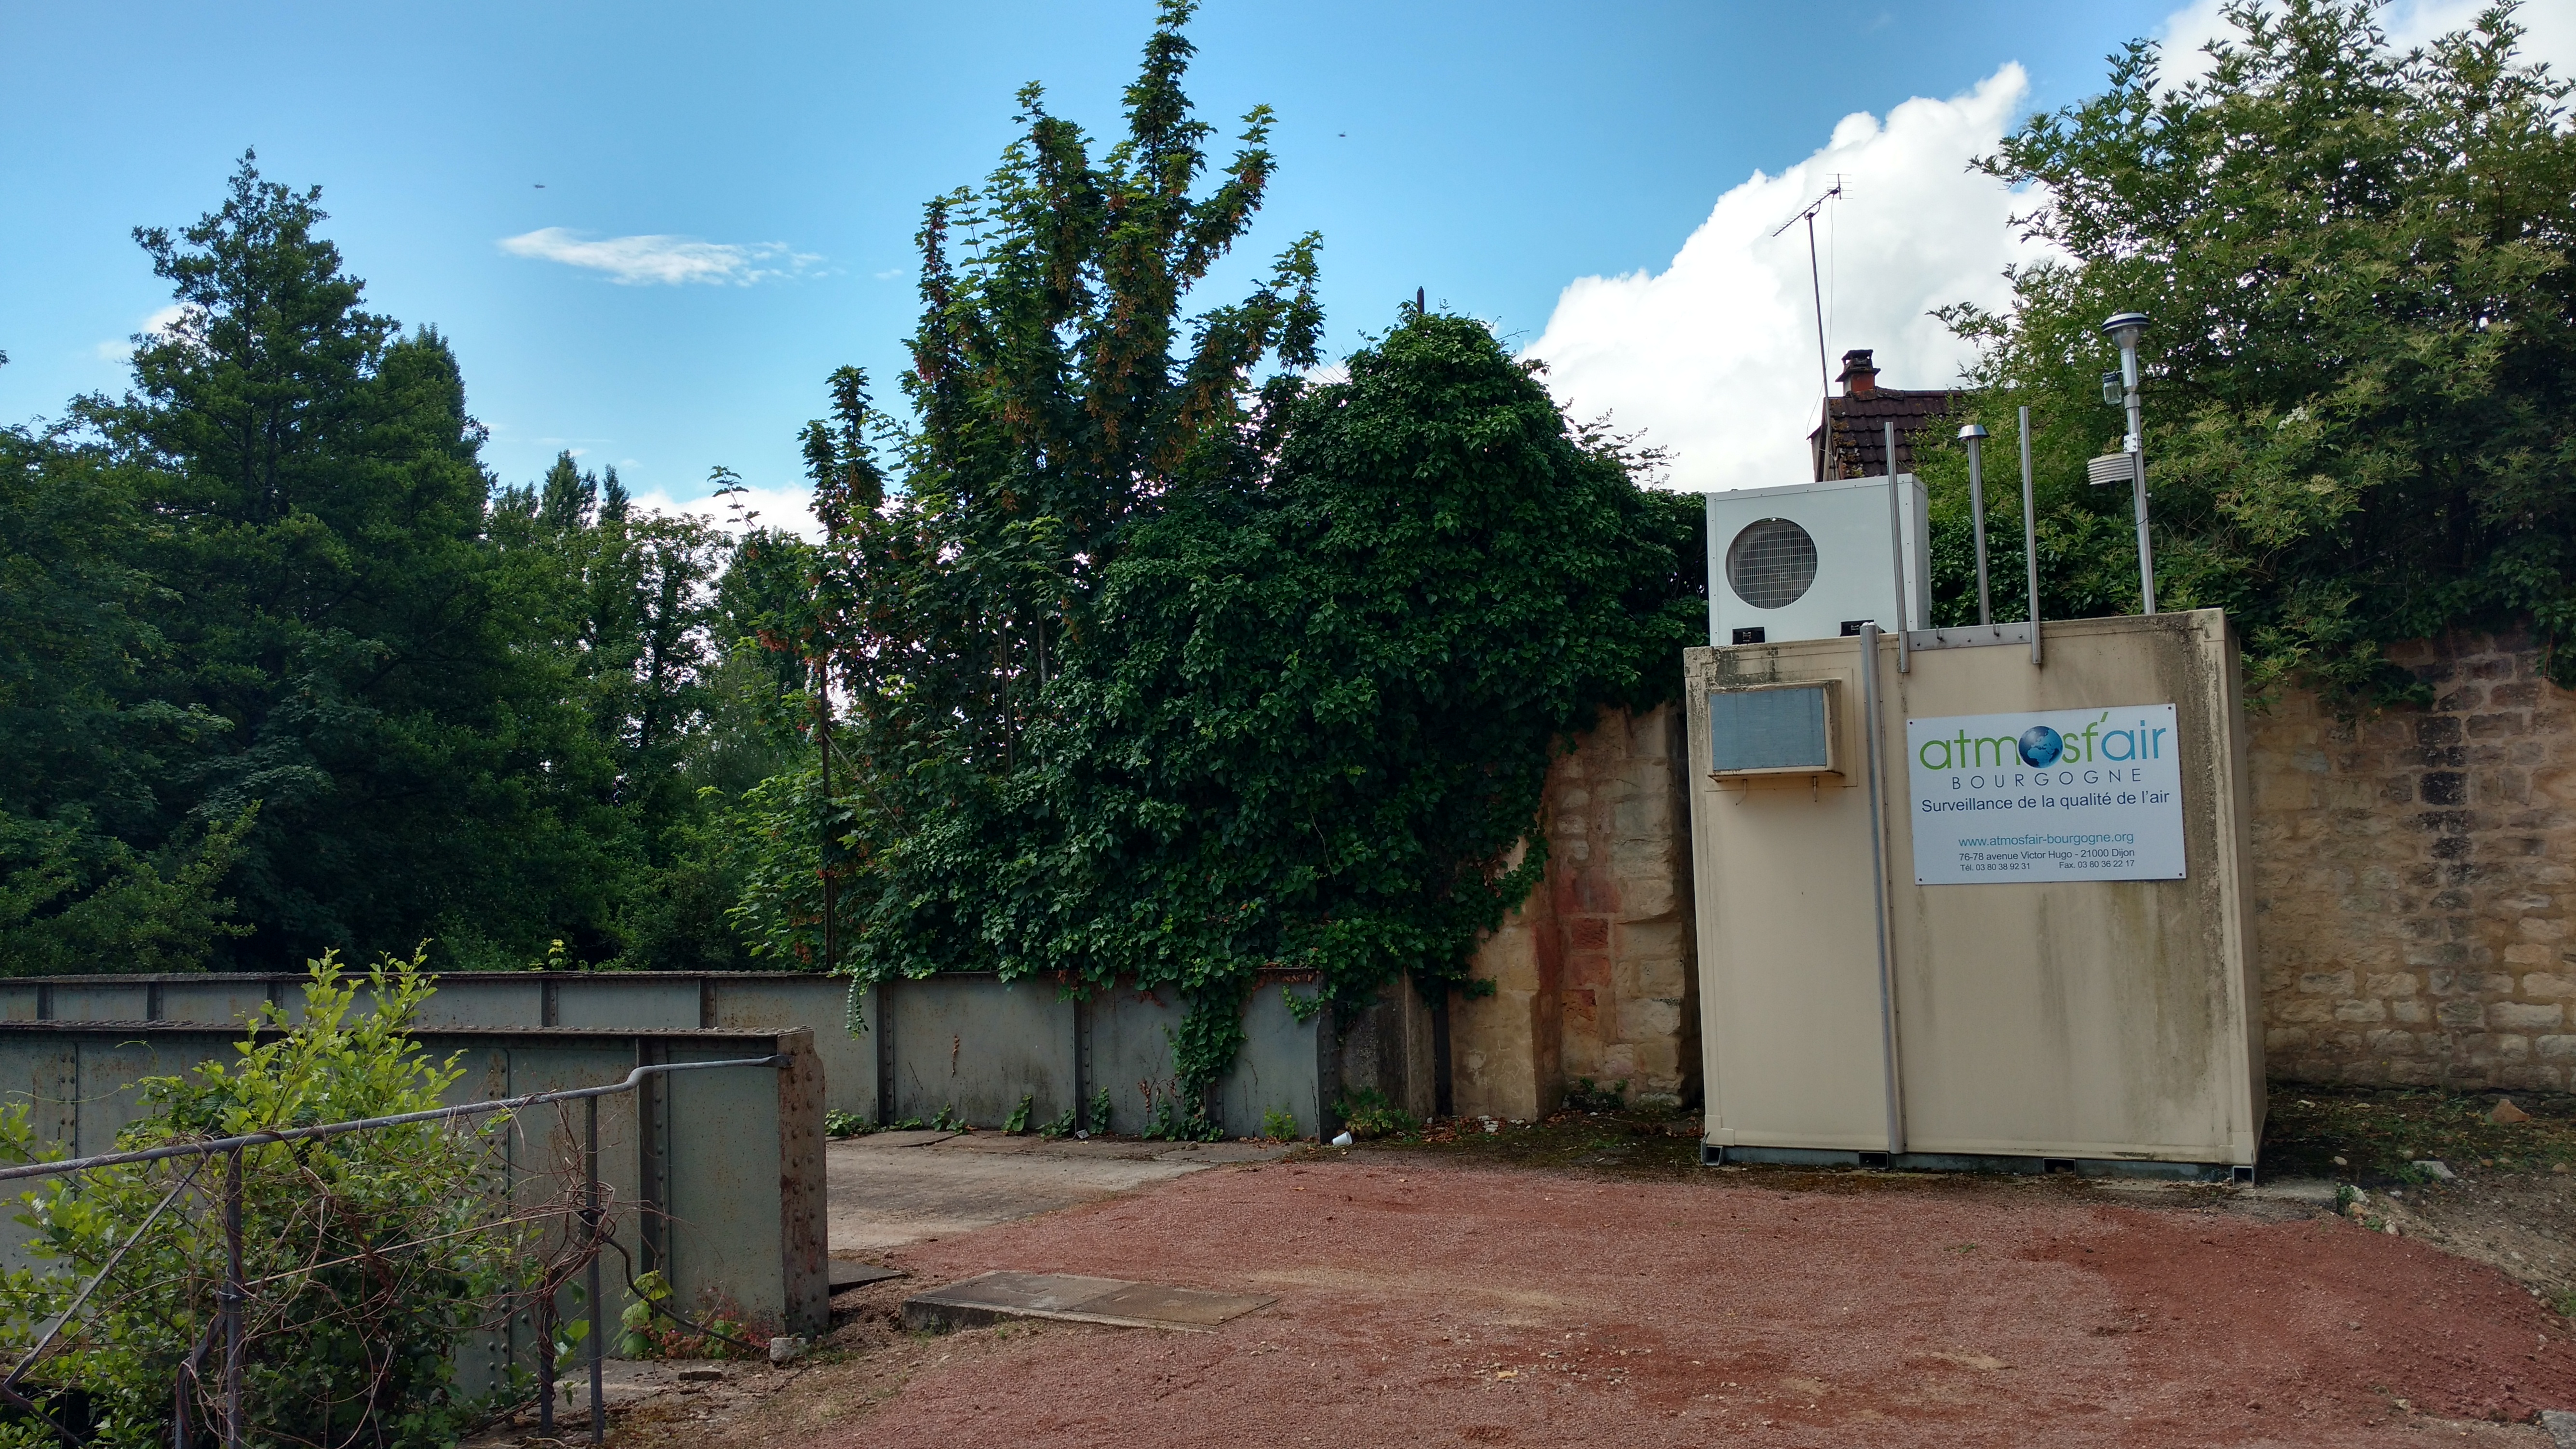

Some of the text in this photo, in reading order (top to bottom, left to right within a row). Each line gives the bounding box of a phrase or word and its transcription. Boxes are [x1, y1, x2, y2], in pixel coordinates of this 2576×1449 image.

[1952, 768, 2141, 790] BOURGOGNE
[1921, 798, 2012, 812] Surveillance
[2018, 796, 2037, 808] de
[2042, 795, 2055, 807] la
[2060, 792, 2111, 810] qualité
[2117, 792, 2136, 805] de
[1959, 833, 2134, 846] www.atmosfair-bourgogne.org
[2048, 850, 2072, 860] Hugo
[2080, 849, 2109, 858] 21000
[2112, 848, 2134, 858] Dijon
